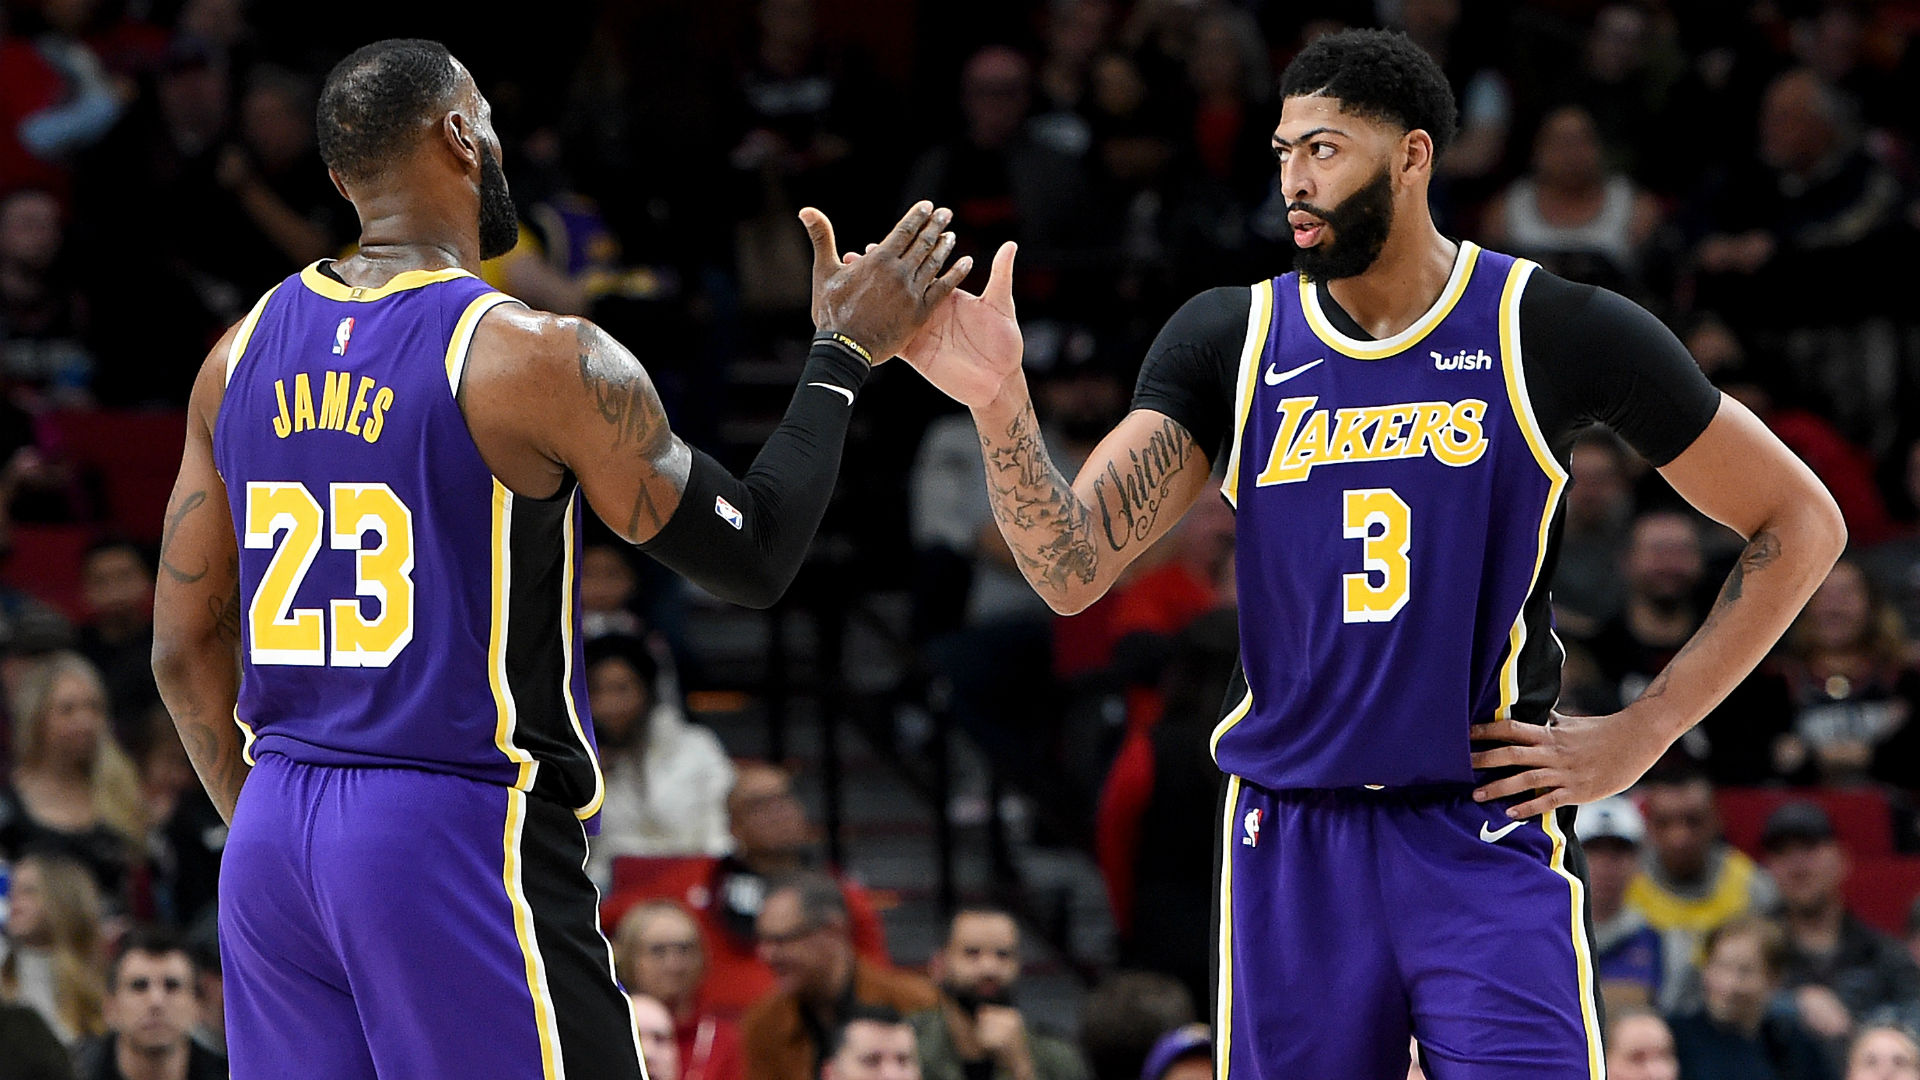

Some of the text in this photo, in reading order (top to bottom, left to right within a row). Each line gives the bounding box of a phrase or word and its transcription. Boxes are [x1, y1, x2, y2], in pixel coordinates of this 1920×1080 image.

[1429, 349, 1492, 371] wish
[272, 370, 394, 444] JAMES
[1255, 395, 1490, 488] LAKERS
[244, 481, 415, 669] 23
[1343, 487, 1412, 624] 3
